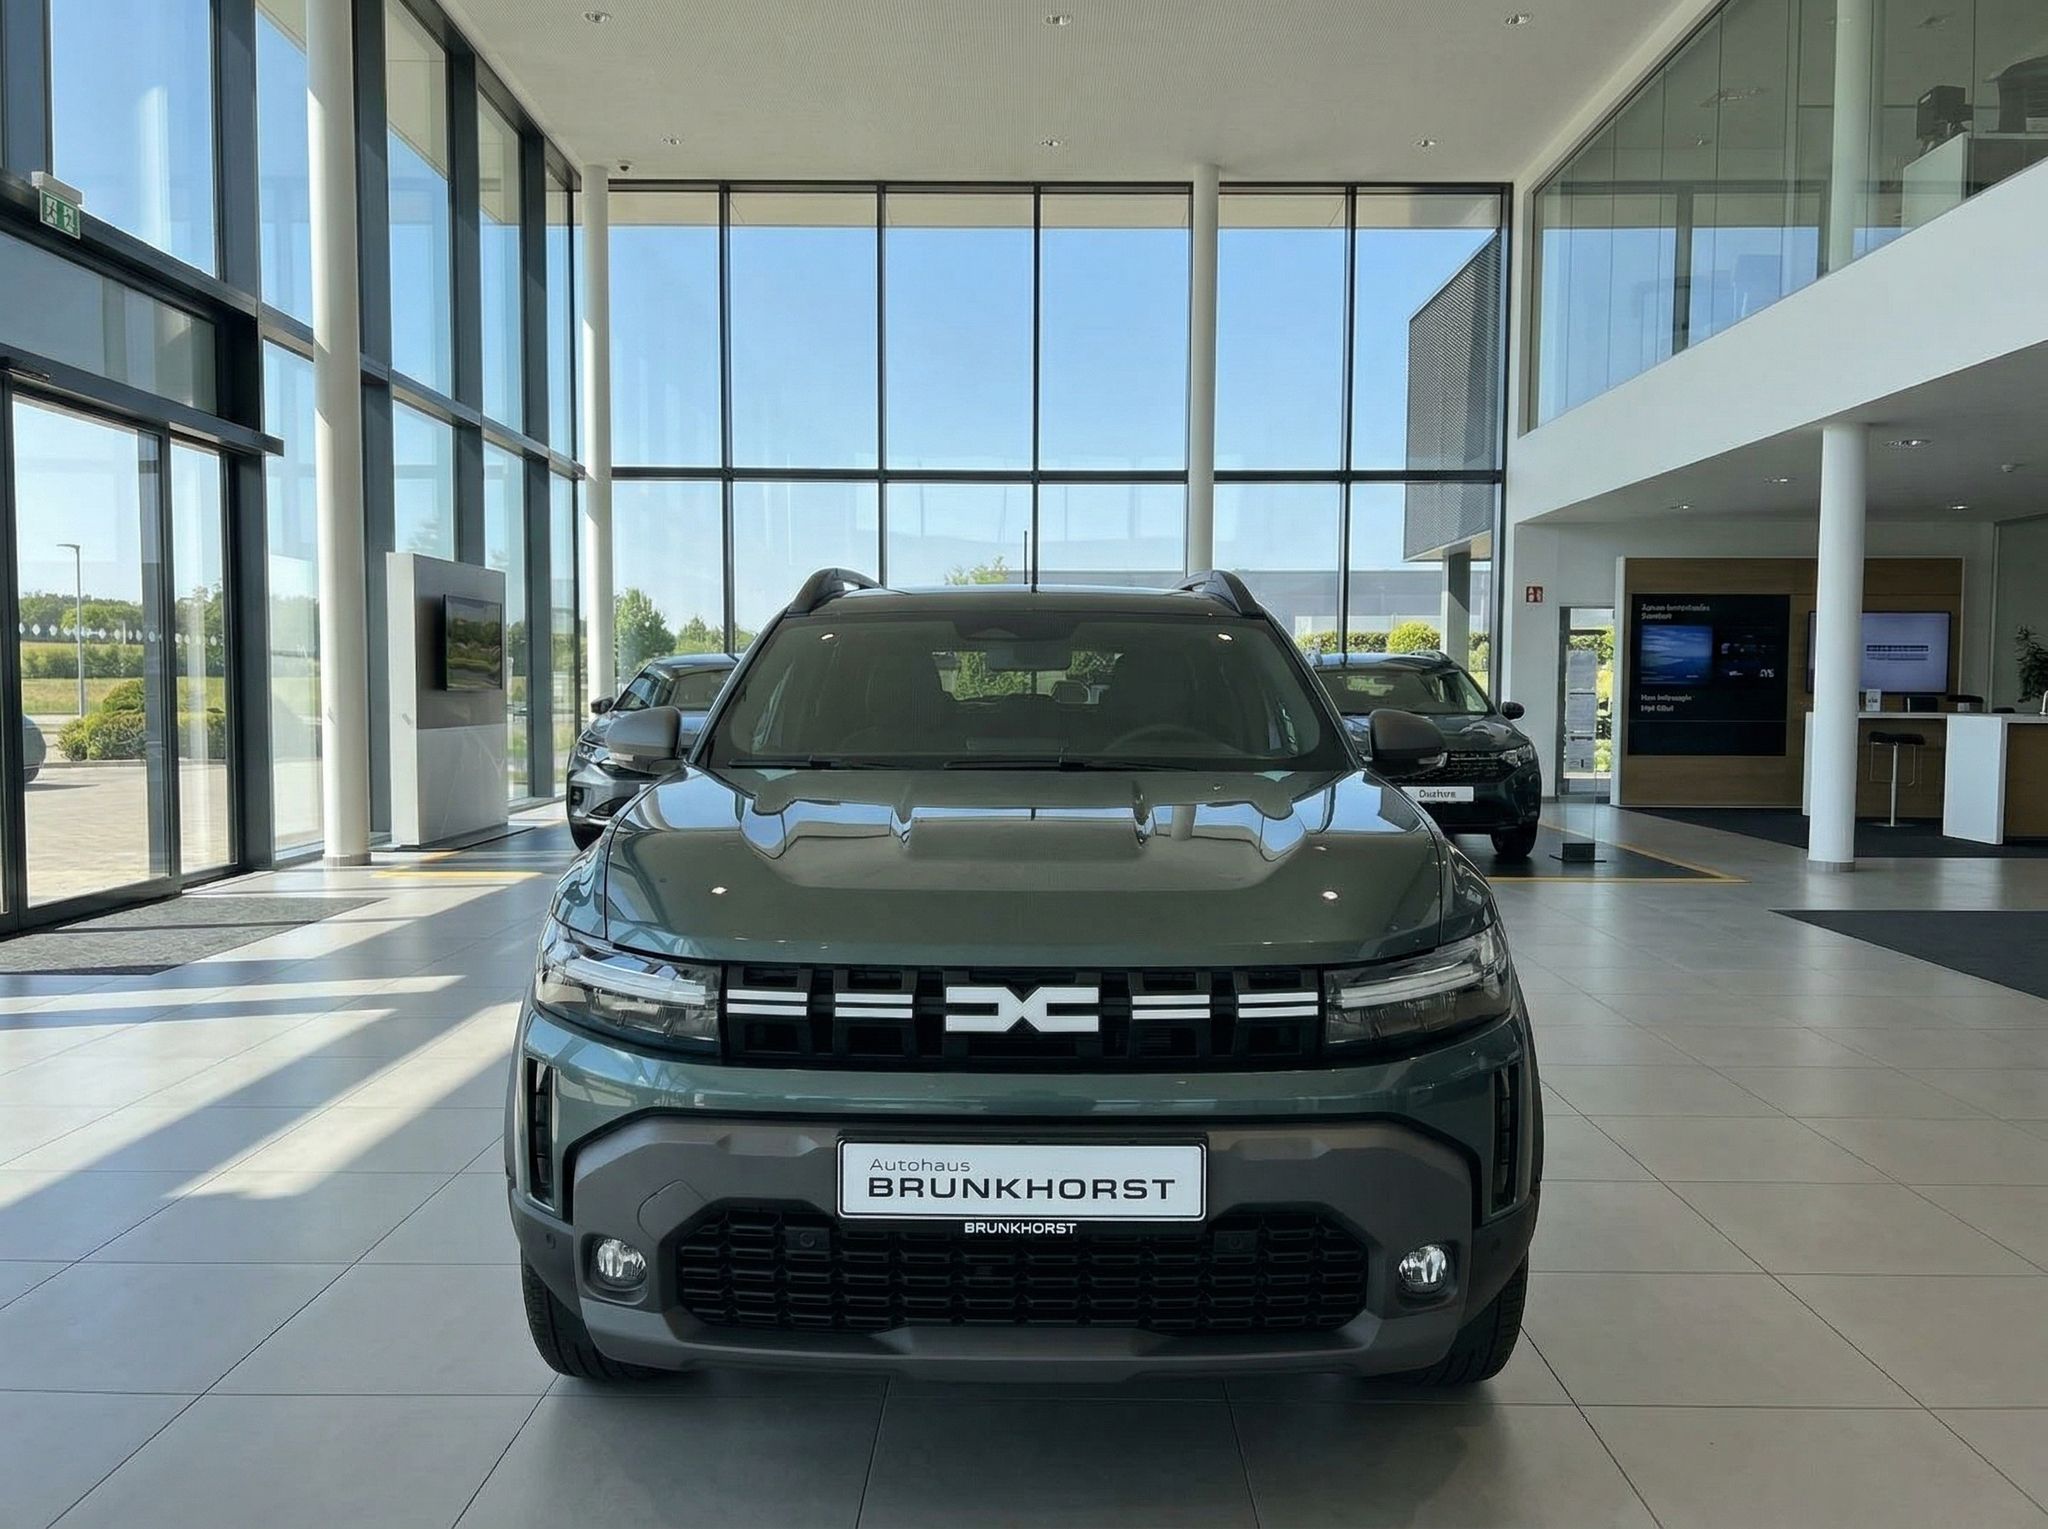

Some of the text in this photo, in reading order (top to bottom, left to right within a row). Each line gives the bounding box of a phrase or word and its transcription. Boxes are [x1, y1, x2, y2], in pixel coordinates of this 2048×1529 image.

[869, 1158, 970, 1172] Autohaus
[868, 1177, 1176, 1200] BRUNKHORST
[964, 1222, 1077, 1234] BRUNKHORST
